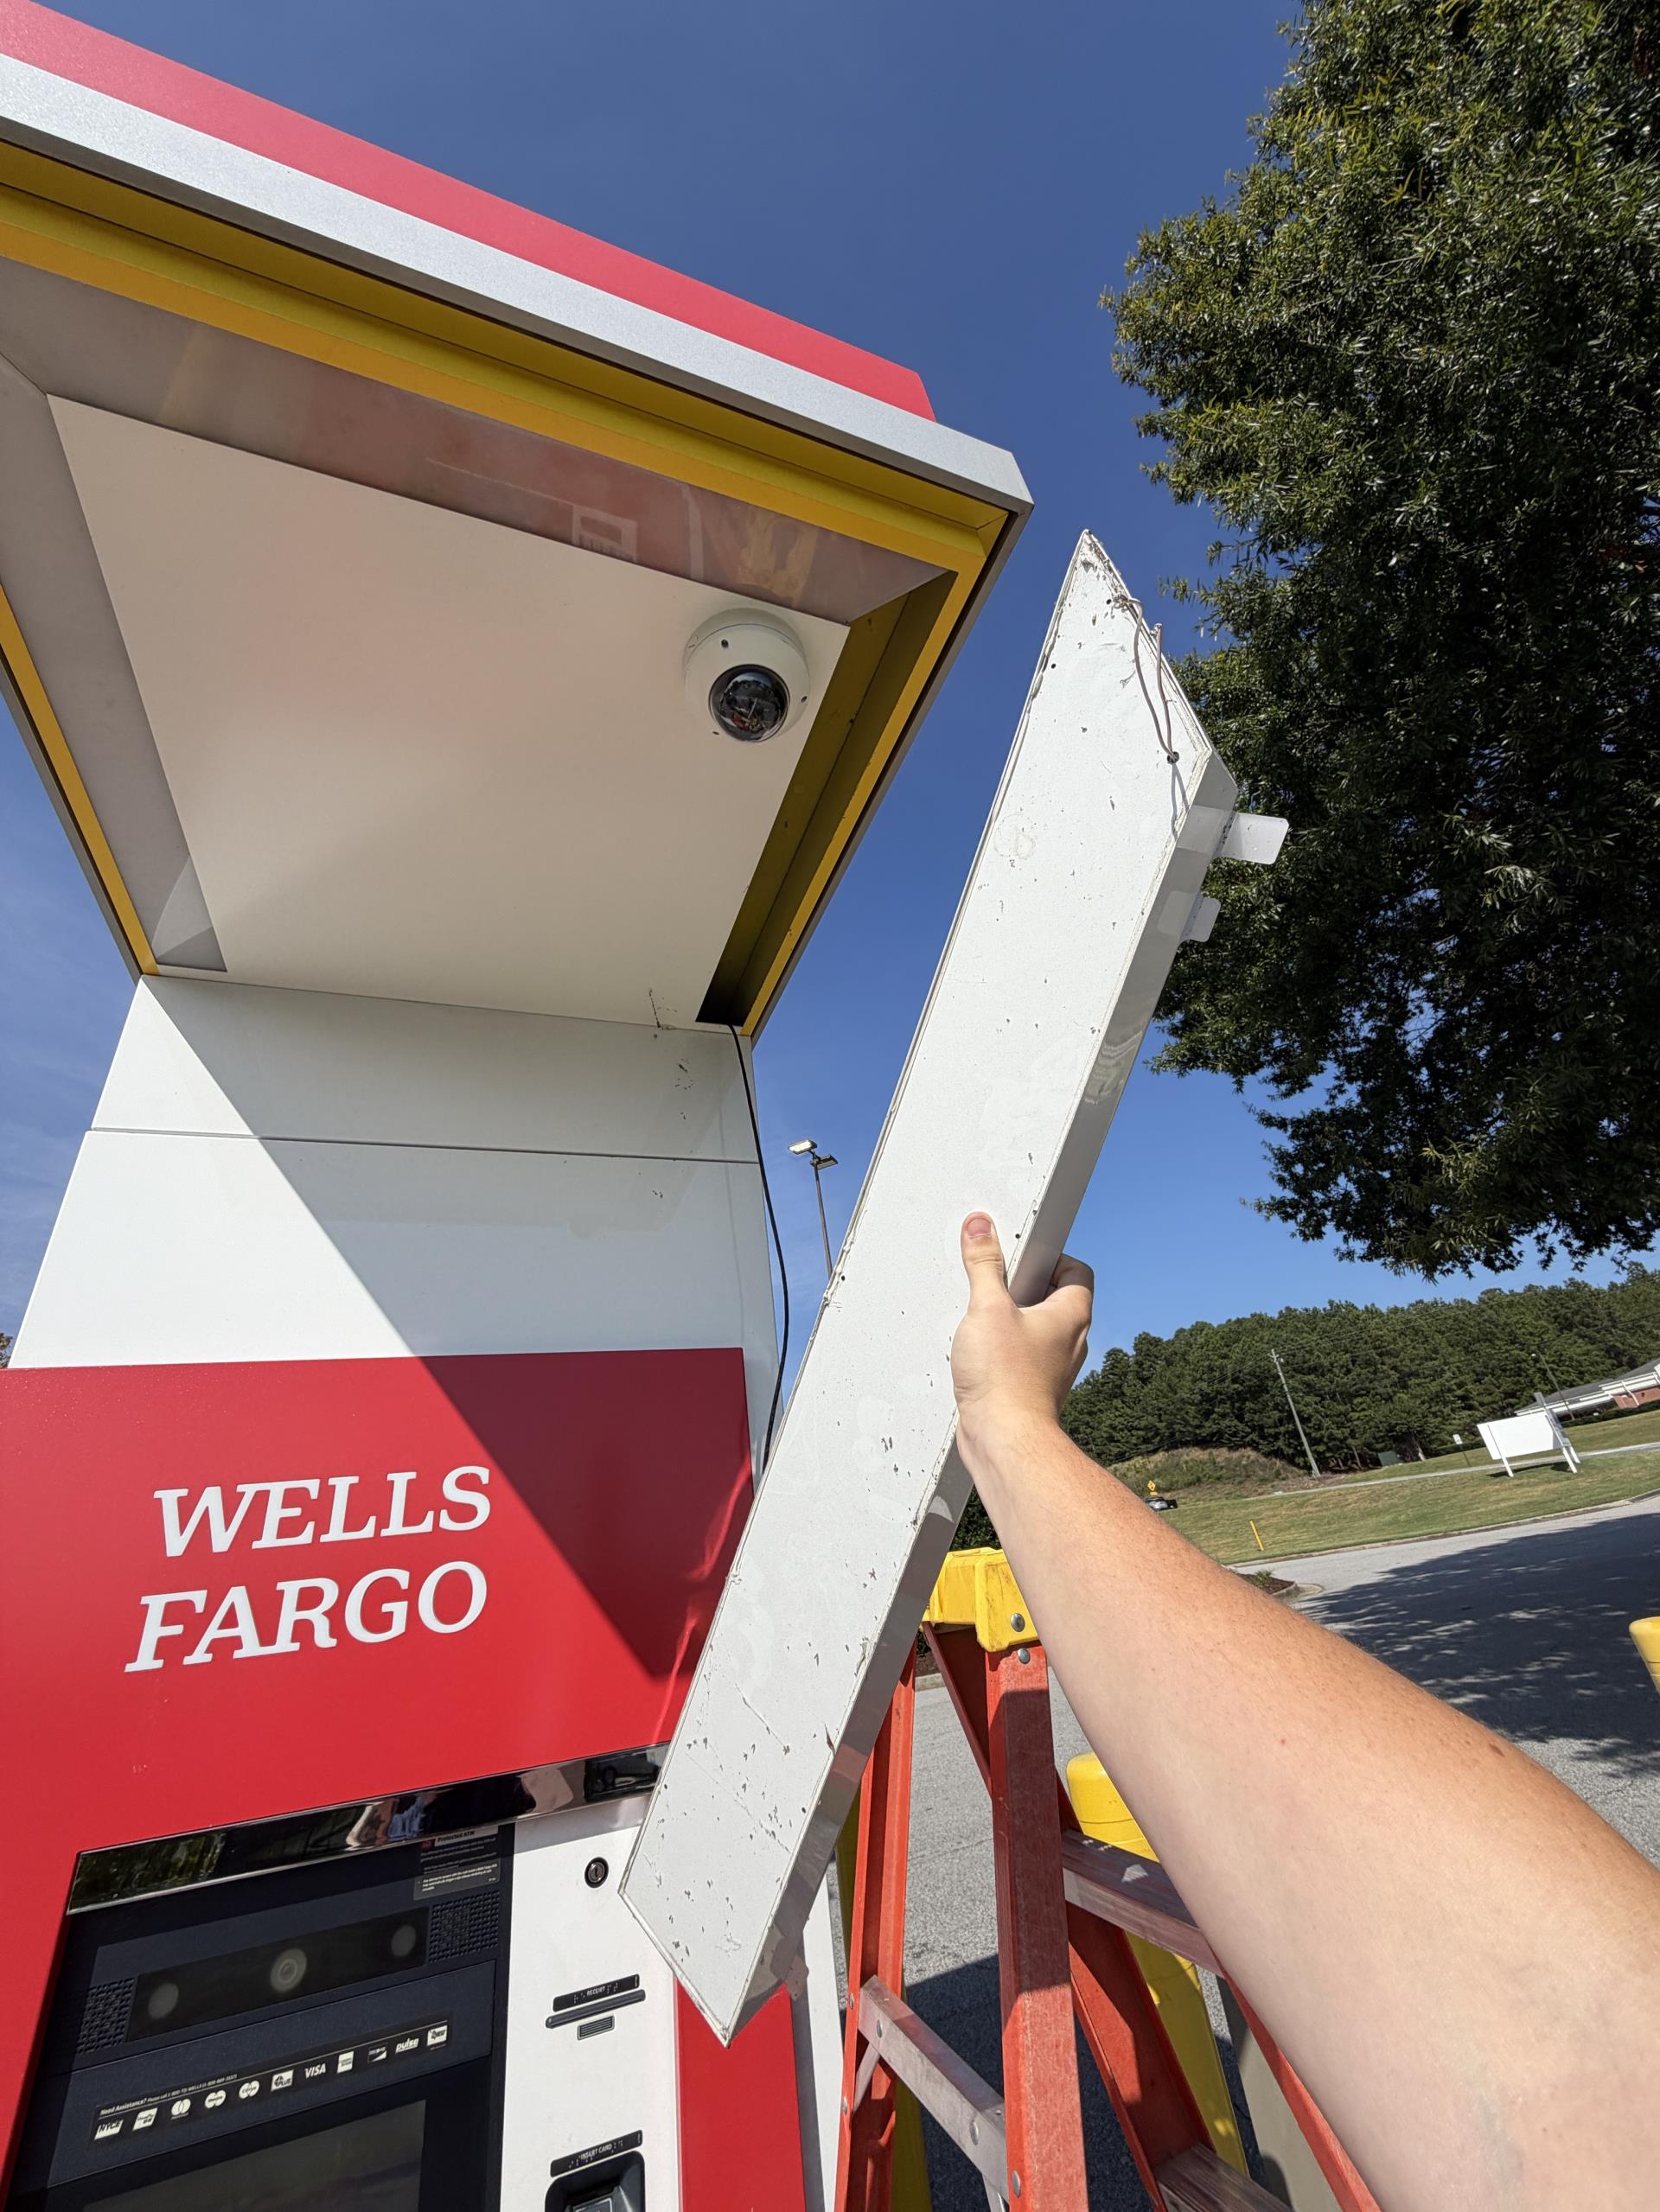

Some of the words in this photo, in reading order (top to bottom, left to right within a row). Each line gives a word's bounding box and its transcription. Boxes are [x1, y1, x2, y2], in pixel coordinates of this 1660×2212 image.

[153, 1465, 492, 1558] WELLS
[124, 1560, 488, 1673] FARGO
[587, 1986, 606, 1996] RECEIPT
[395, 2037, 419, 2052] pulse
[304, 2062, 326, 2079] VISA
[277, 2077, 291, 2087] PLUS
[100, 2106, 116, 2115] Need
[115, 2098, 147, 2110] Assistance?
[580, 2148, 598, 2159] INSERT
[598, 2144, 612, 2153] CARD
